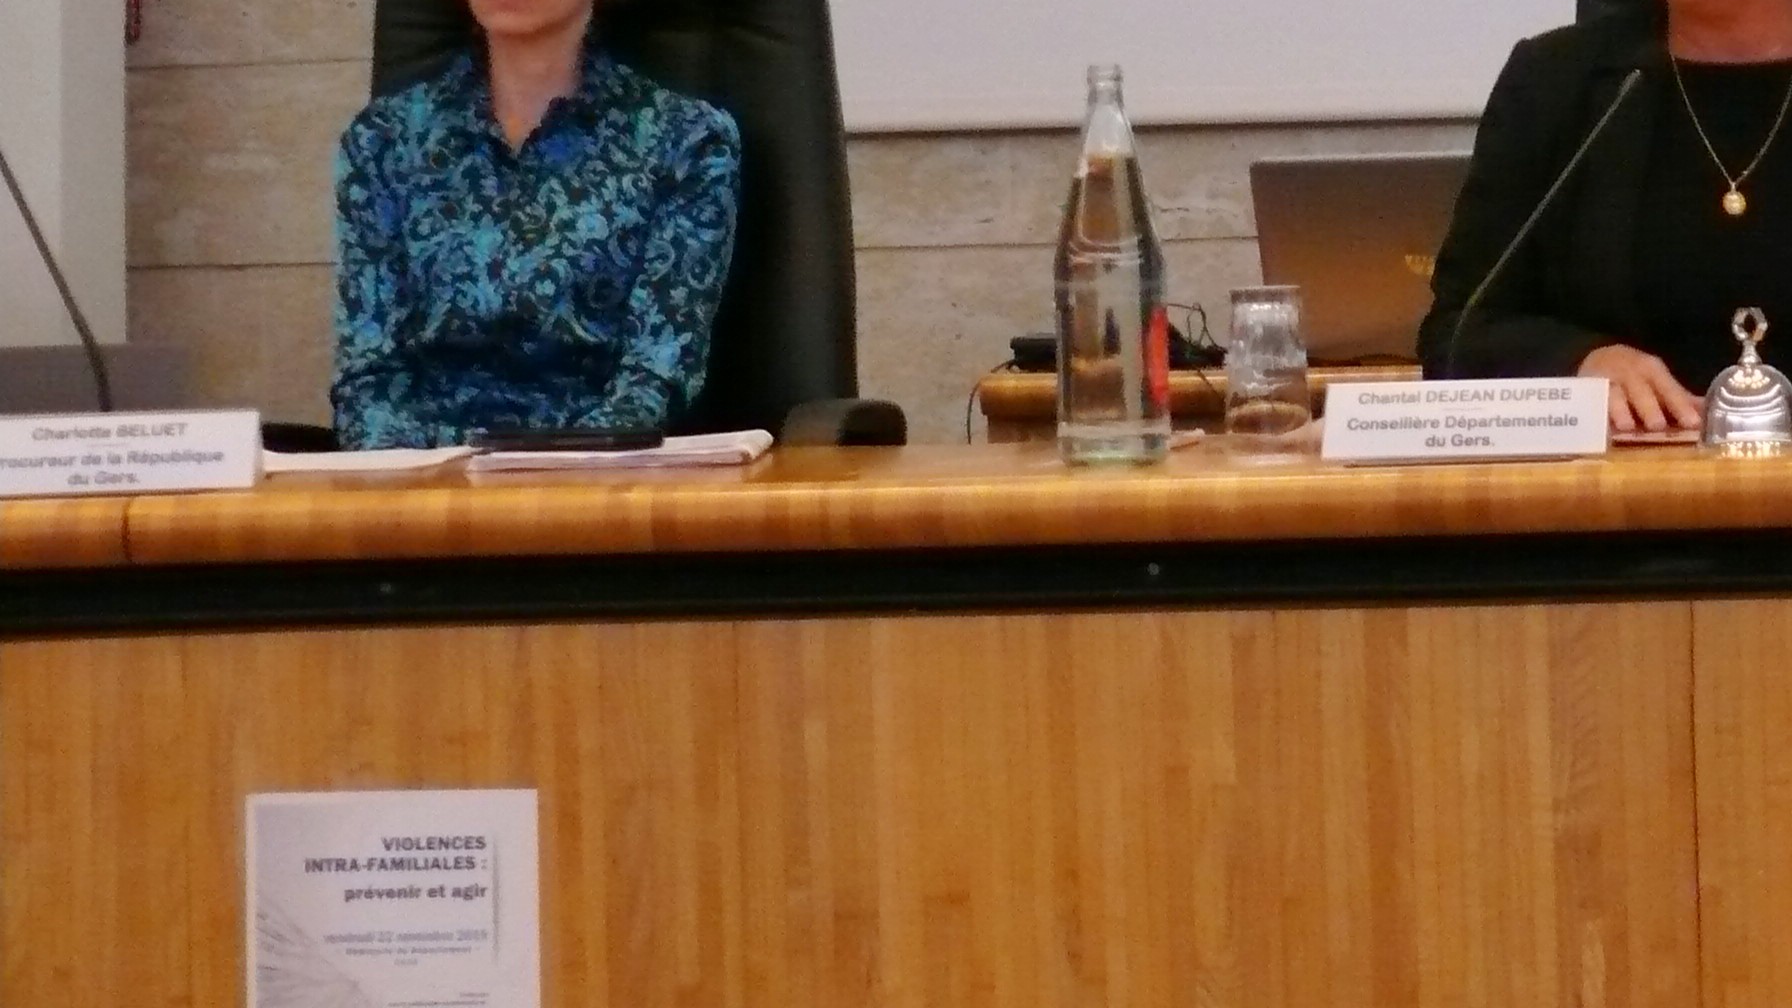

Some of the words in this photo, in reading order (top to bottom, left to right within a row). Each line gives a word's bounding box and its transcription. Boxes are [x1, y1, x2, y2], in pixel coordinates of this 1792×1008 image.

[1358, 388, 1421, 406] Chantal
[1425, 389, 1495, 403] DEJEAN
[1347, 415, 1441, 432] Conseillière
[1445, 412, 1578, 431] Départementale
[1425, 433, 1446, 448] du
[1450, 432, 1495, 448] Gers.
[382, 836, 486, 851] VIOLENCES
[304, 856, 475, 873] INTRA-FAMILIALES
[344, 886, 421, 903] prévenir
[427, 885, 446, 898] et
[452, 884, 488, 901] agir
